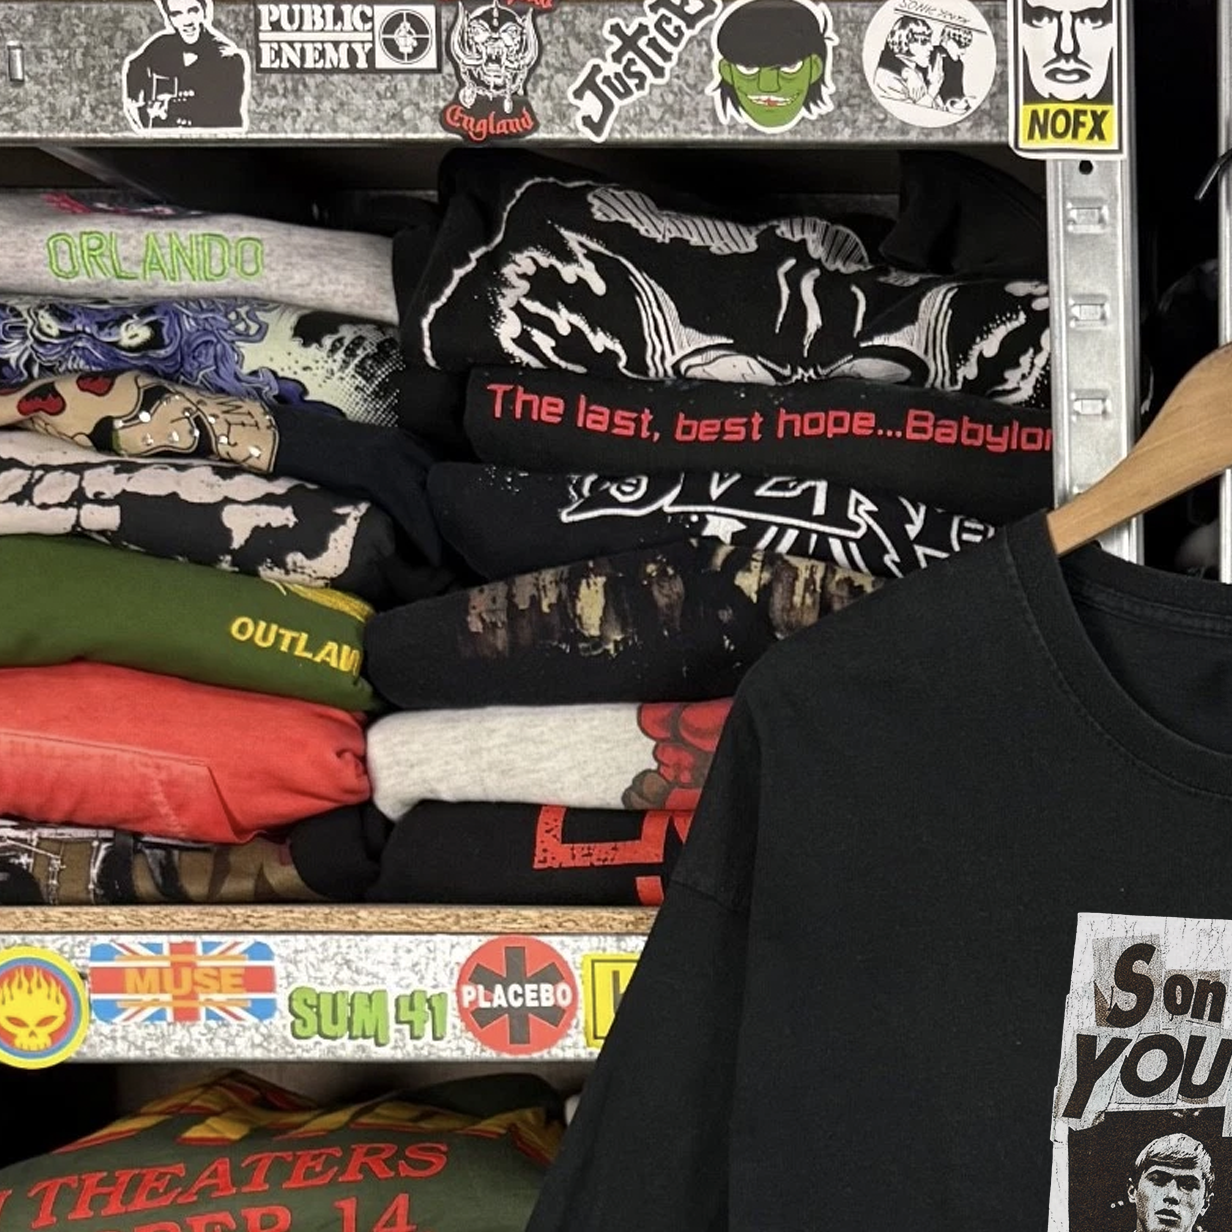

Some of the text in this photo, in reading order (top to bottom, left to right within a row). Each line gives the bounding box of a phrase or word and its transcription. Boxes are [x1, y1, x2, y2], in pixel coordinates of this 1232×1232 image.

[258, 4, 373, 31] PUBLIC
[258, 42, 373, 69] ENEMY
[444, 104, 535, 141] England
[1027, 108, 1110, 141] NOFX
[47, 232, 264, 282] ORLANDO
[487, 384, 565, 424] The
[576, 393, 660, 442] last,
[674, 410, 764, 442] best
[124, 966, 245, 997] MUSE
[461, 981, 572, 1010] PLACEBO
[289, 986, 449, 1047] SUM 41
[27, 1143, 448, 1229] THEATERS
